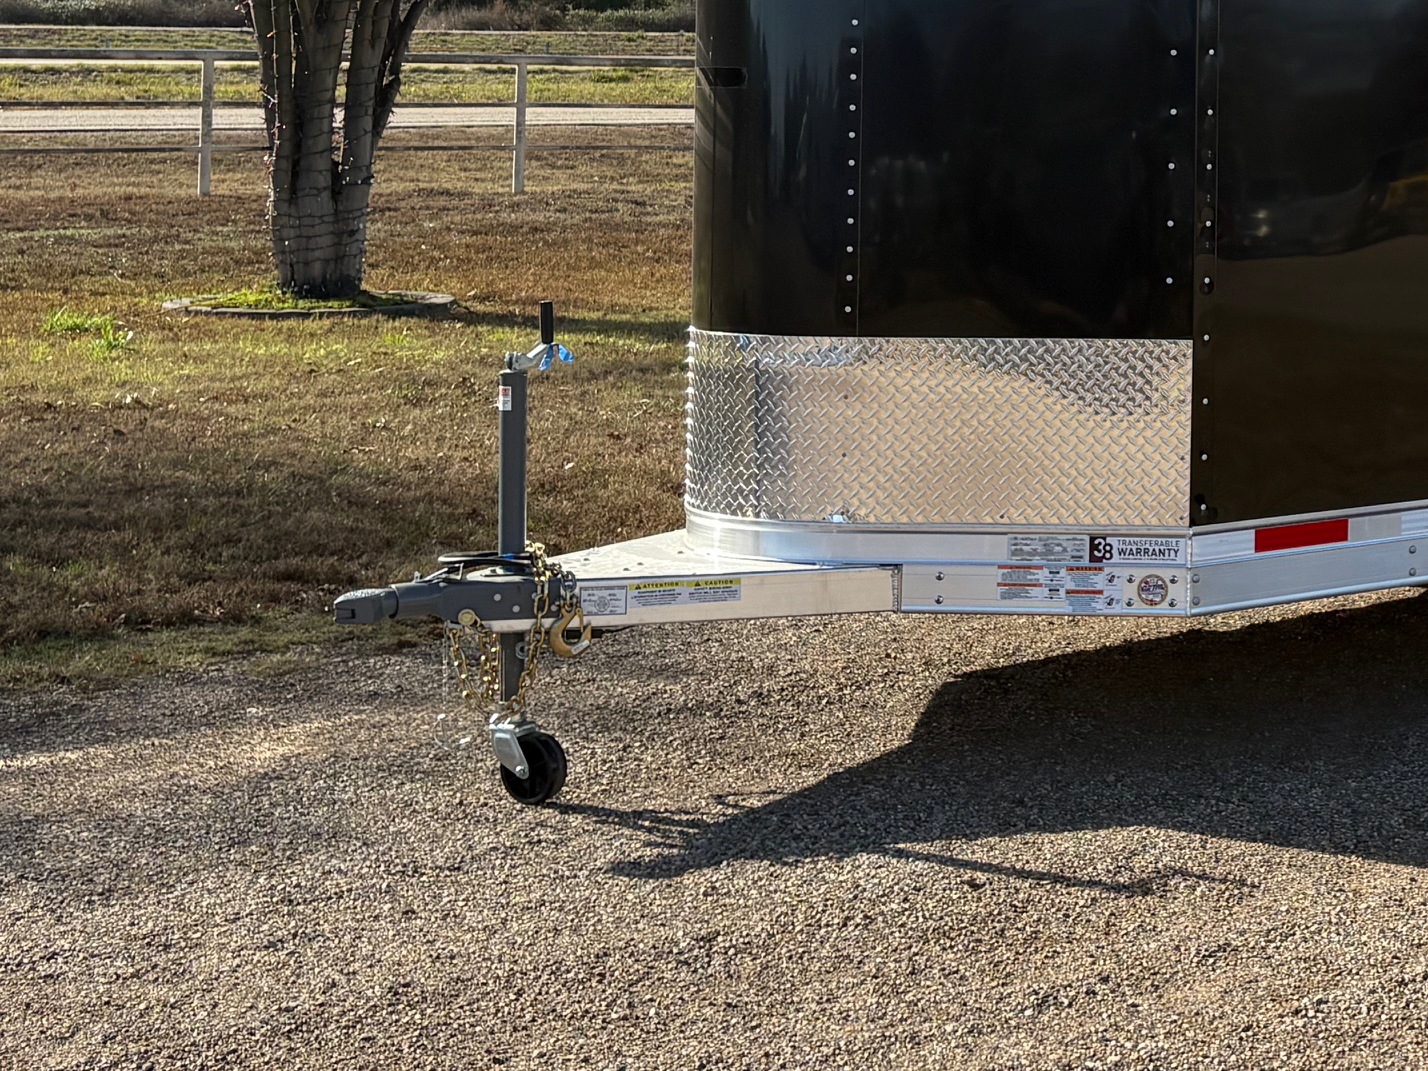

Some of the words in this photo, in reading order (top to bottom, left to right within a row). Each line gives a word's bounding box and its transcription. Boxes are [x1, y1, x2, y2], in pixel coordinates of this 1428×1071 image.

[1117, 539, 1181, 548] TRANSFERABLE
[1117, 547, 1180, 558] WARRANTY
[643, 581, 679, 589] ATTENTION
